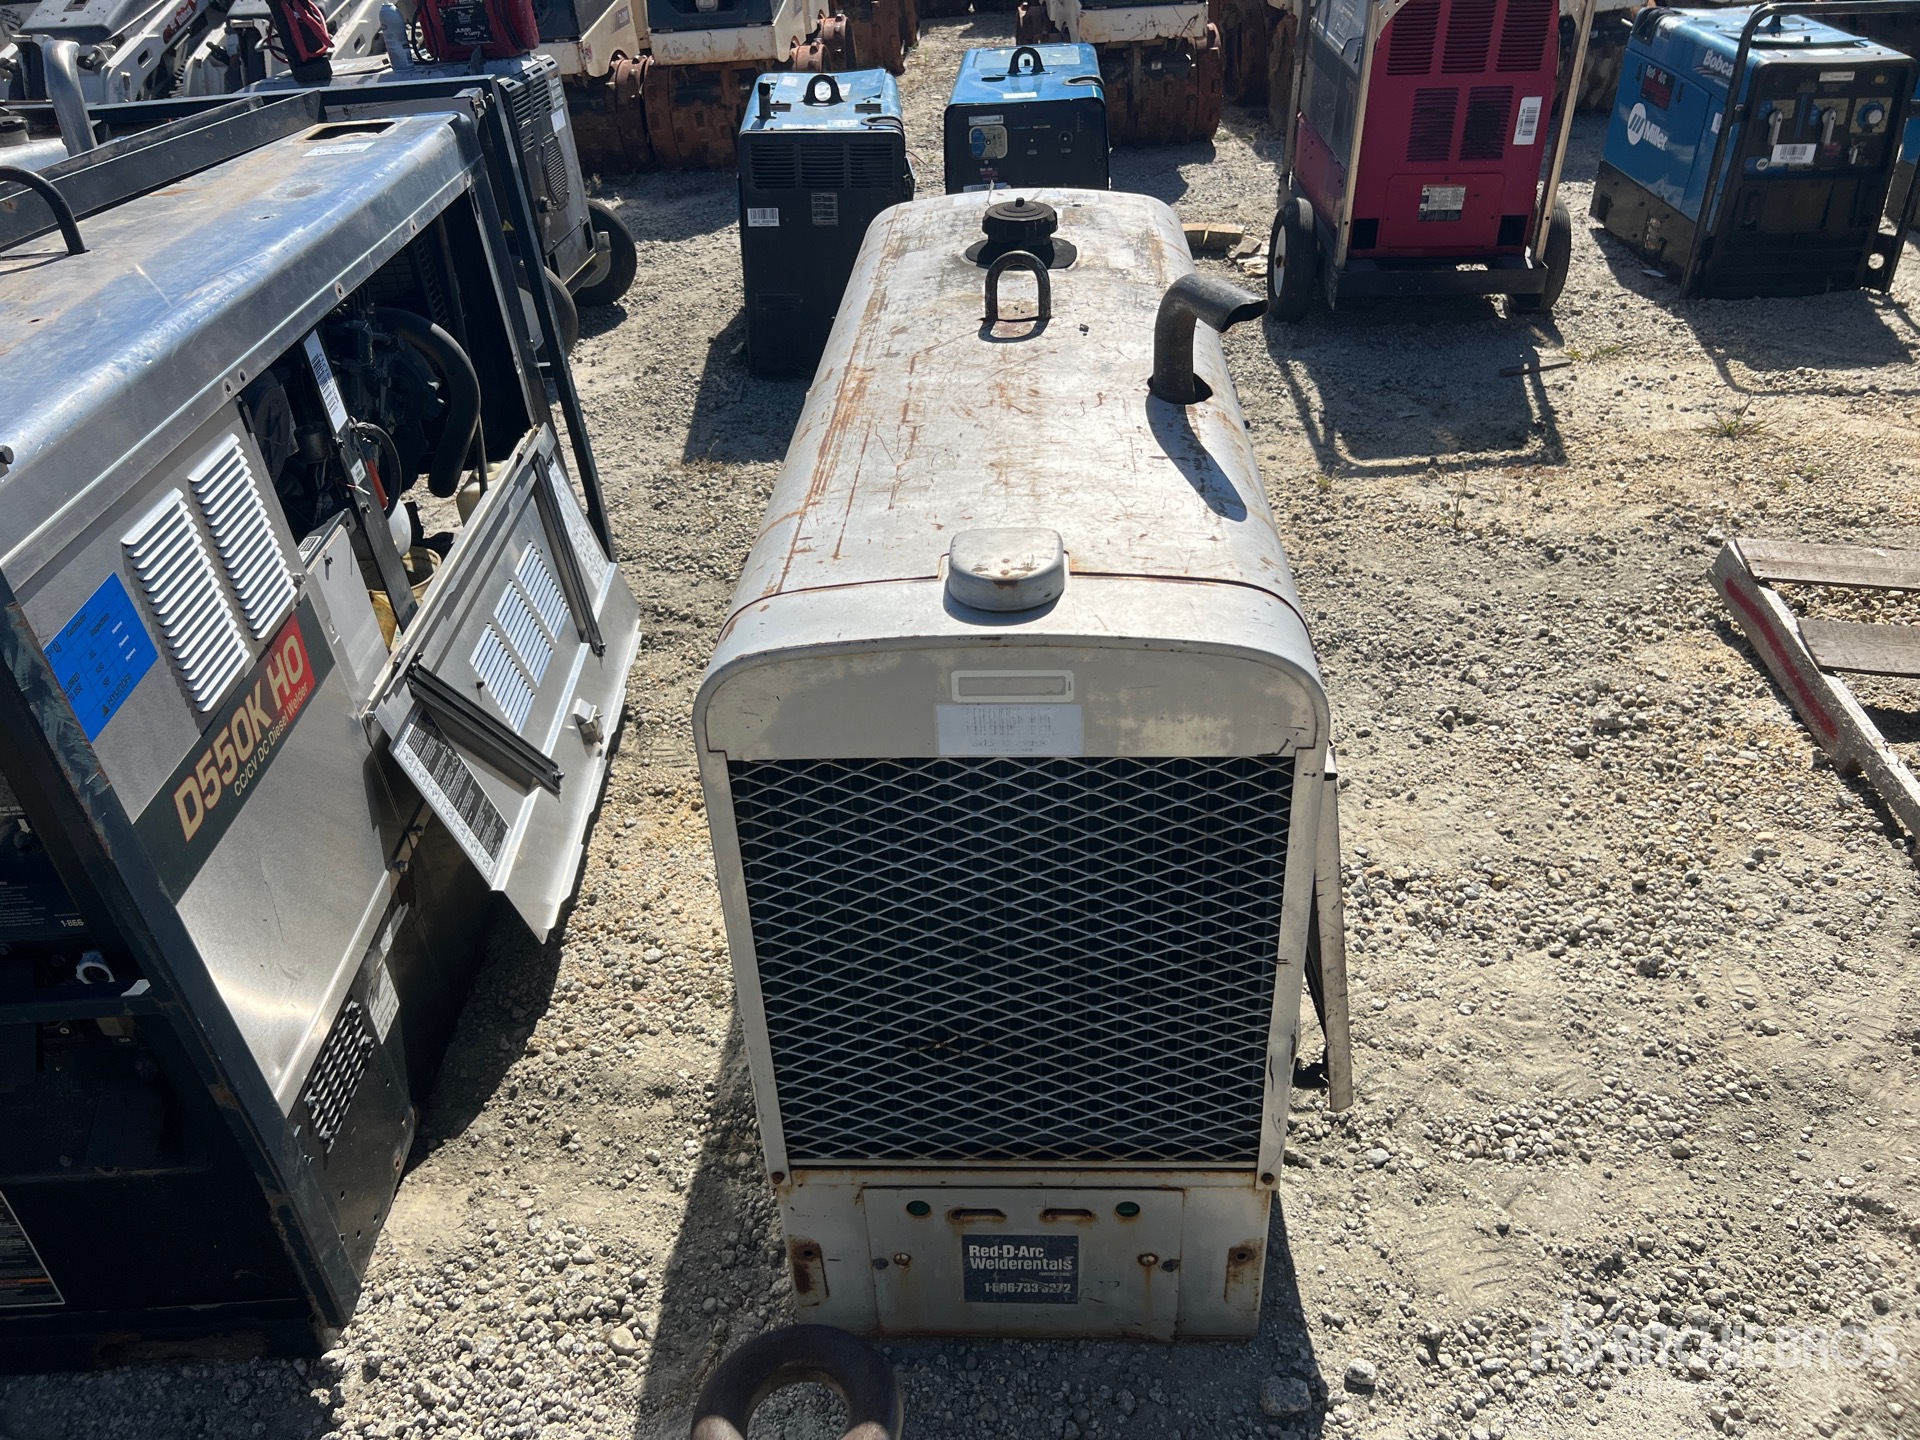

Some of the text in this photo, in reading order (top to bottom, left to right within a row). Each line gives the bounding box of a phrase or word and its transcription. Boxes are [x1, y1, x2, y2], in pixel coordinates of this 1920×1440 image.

[1703, 49, 1735, 77] Bobca
[1644, 121, 1669, 151] Miller
[173, 635, 305, 843] D550K HO
[234, 683, 309, 797] CC/CV DC Diesel Welder
[969, 1245, 1044, 1258] Red-D-Arc
[970, 1257, 1073, 1271] Welderentals
